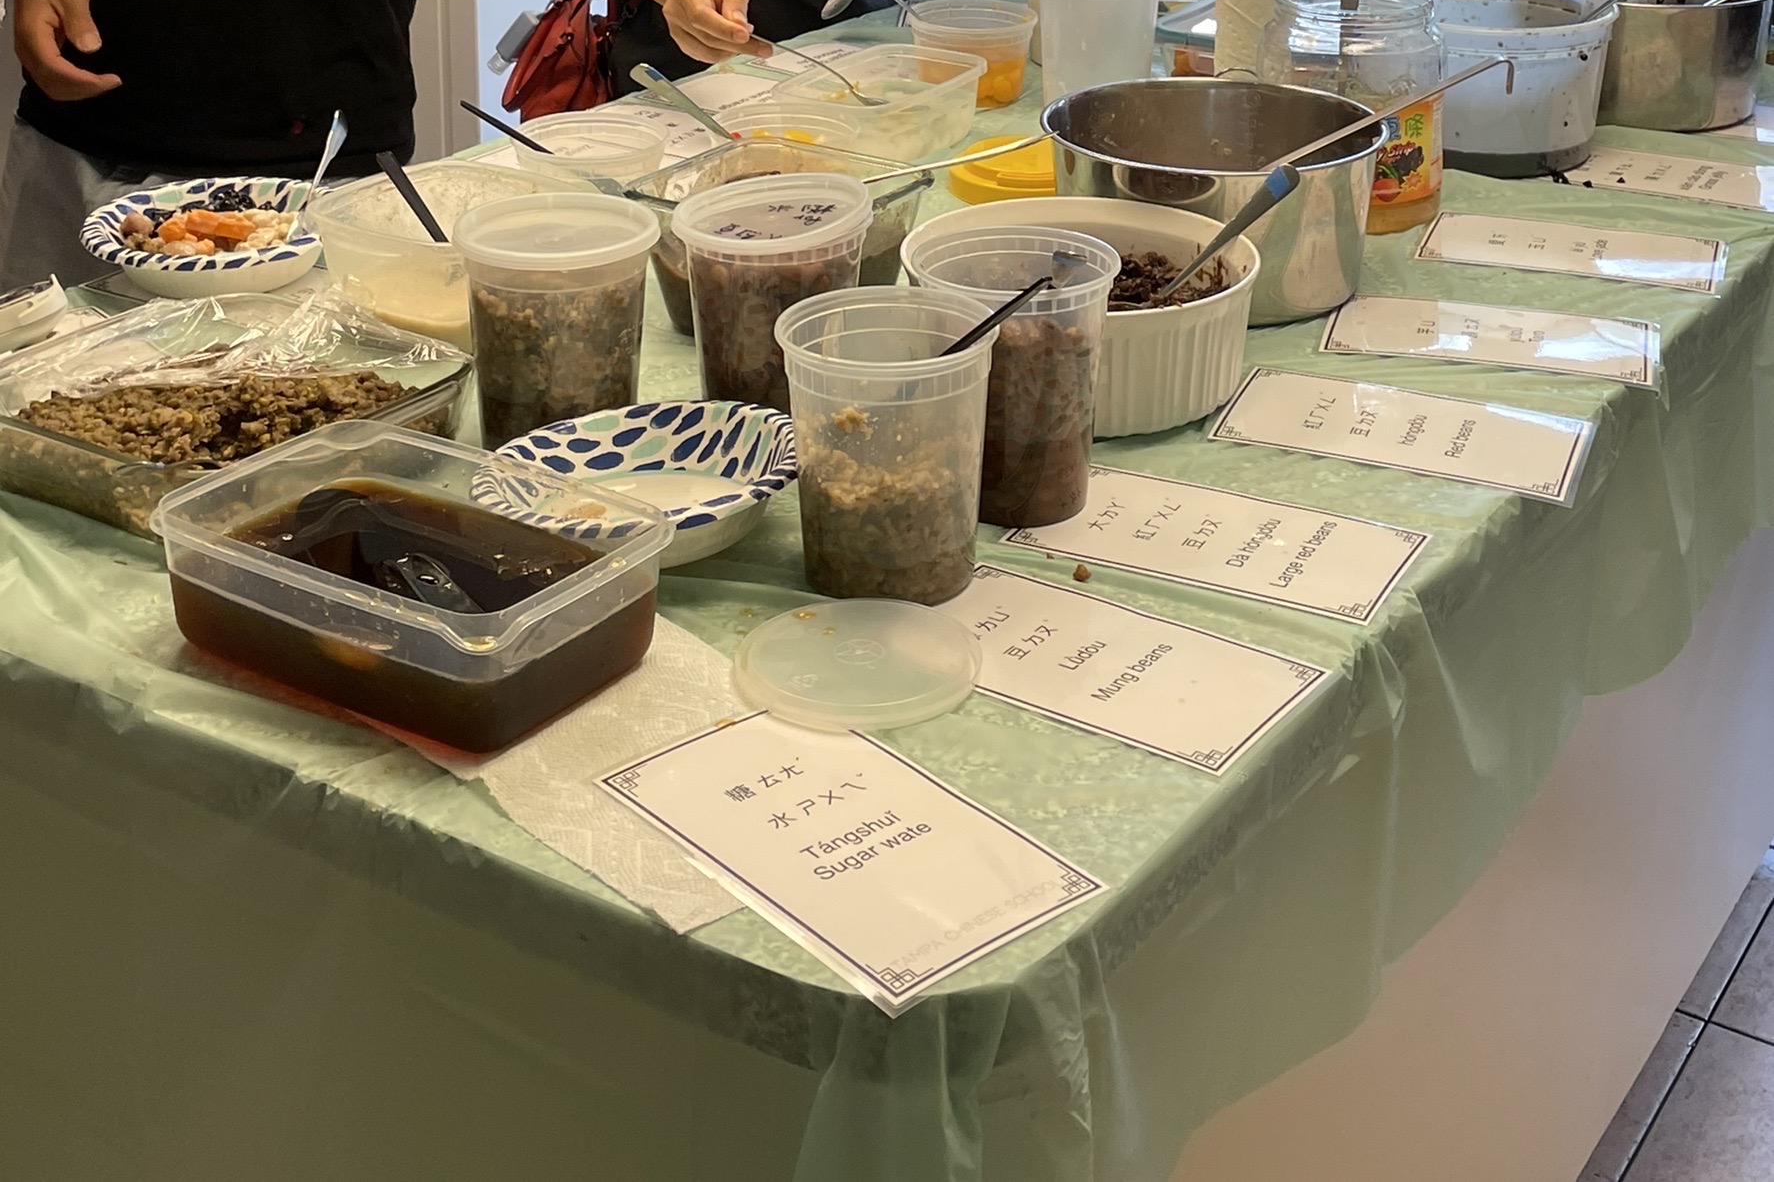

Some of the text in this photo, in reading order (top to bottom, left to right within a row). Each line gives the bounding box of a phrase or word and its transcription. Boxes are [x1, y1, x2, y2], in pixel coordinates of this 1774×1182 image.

[1444, 419, 1478, 459] Red beans
[1226, 552, 1250, 569] Dà
[1269, 520, 1338, 589] Large red beans
[1091, 643, 1173, 702] Mung beans
[813, 821, 932, 881] Sugar wate
